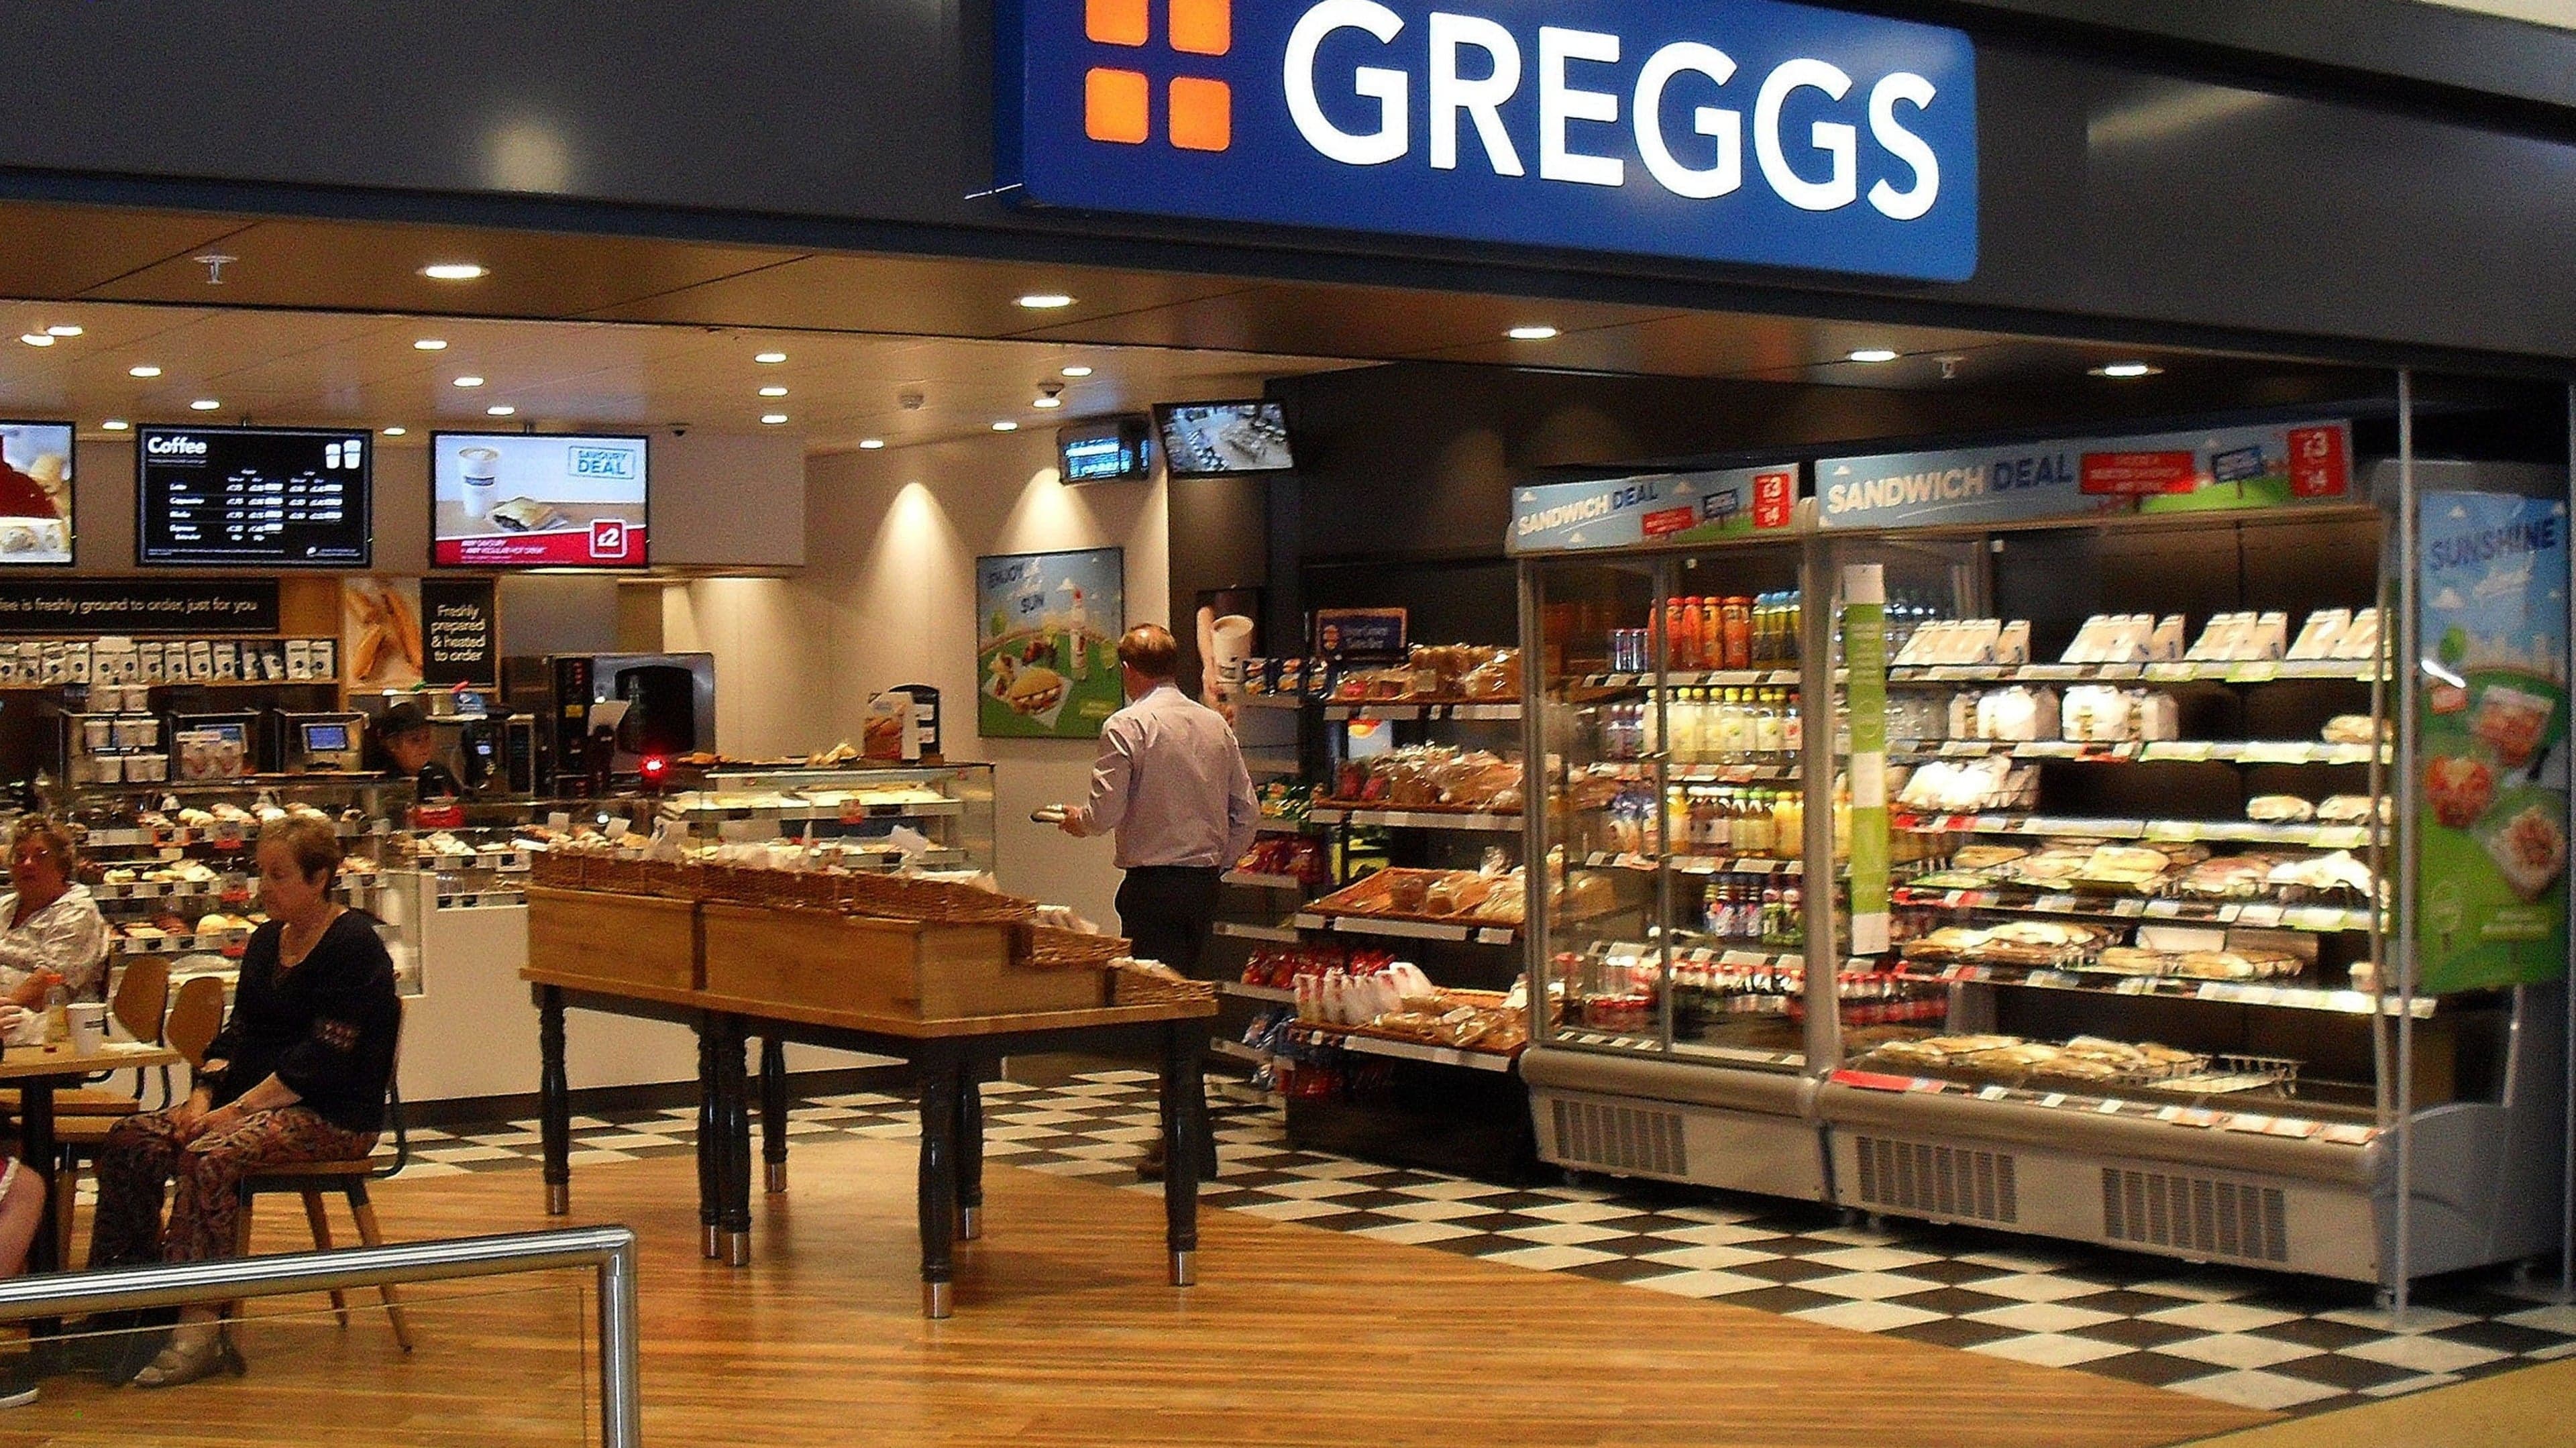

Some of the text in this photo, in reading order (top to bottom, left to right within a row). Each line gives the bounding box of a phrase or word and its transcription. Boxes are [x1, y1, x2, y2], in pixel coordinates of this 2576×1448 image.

[1283, 0, 1939, 221] GREGGS
[148, 437, 207, 454] Coffee
[578, 459, 626, 475] DEAL
[1827, 466, 1986, 514] SANDWICH
[1992, 453, 2074, 490] DEAL
[1517, 494, 1609, 536] SANDWICH
[1612, 482, 1660, 510] DEAL
[597, 528, 620, 547] £2
[2429, 515, 2557, 572] SUNSHINE
[35, 598, 79, 614] freshly
[80, 598, 129, 614] ground
[131, 600, 145, 611] to
[186, 598, 211, 615] just
[213, 596, 229, 611] for
[233, 601, 258, 614] you
[437, 604, 480, 620] Freshly
[1020, 592, 1045, 613] SUN
[431, 618, 486, 634] prepared
[431, 634, 486, 648] & heated
[434, 649, 483, 661] to order
